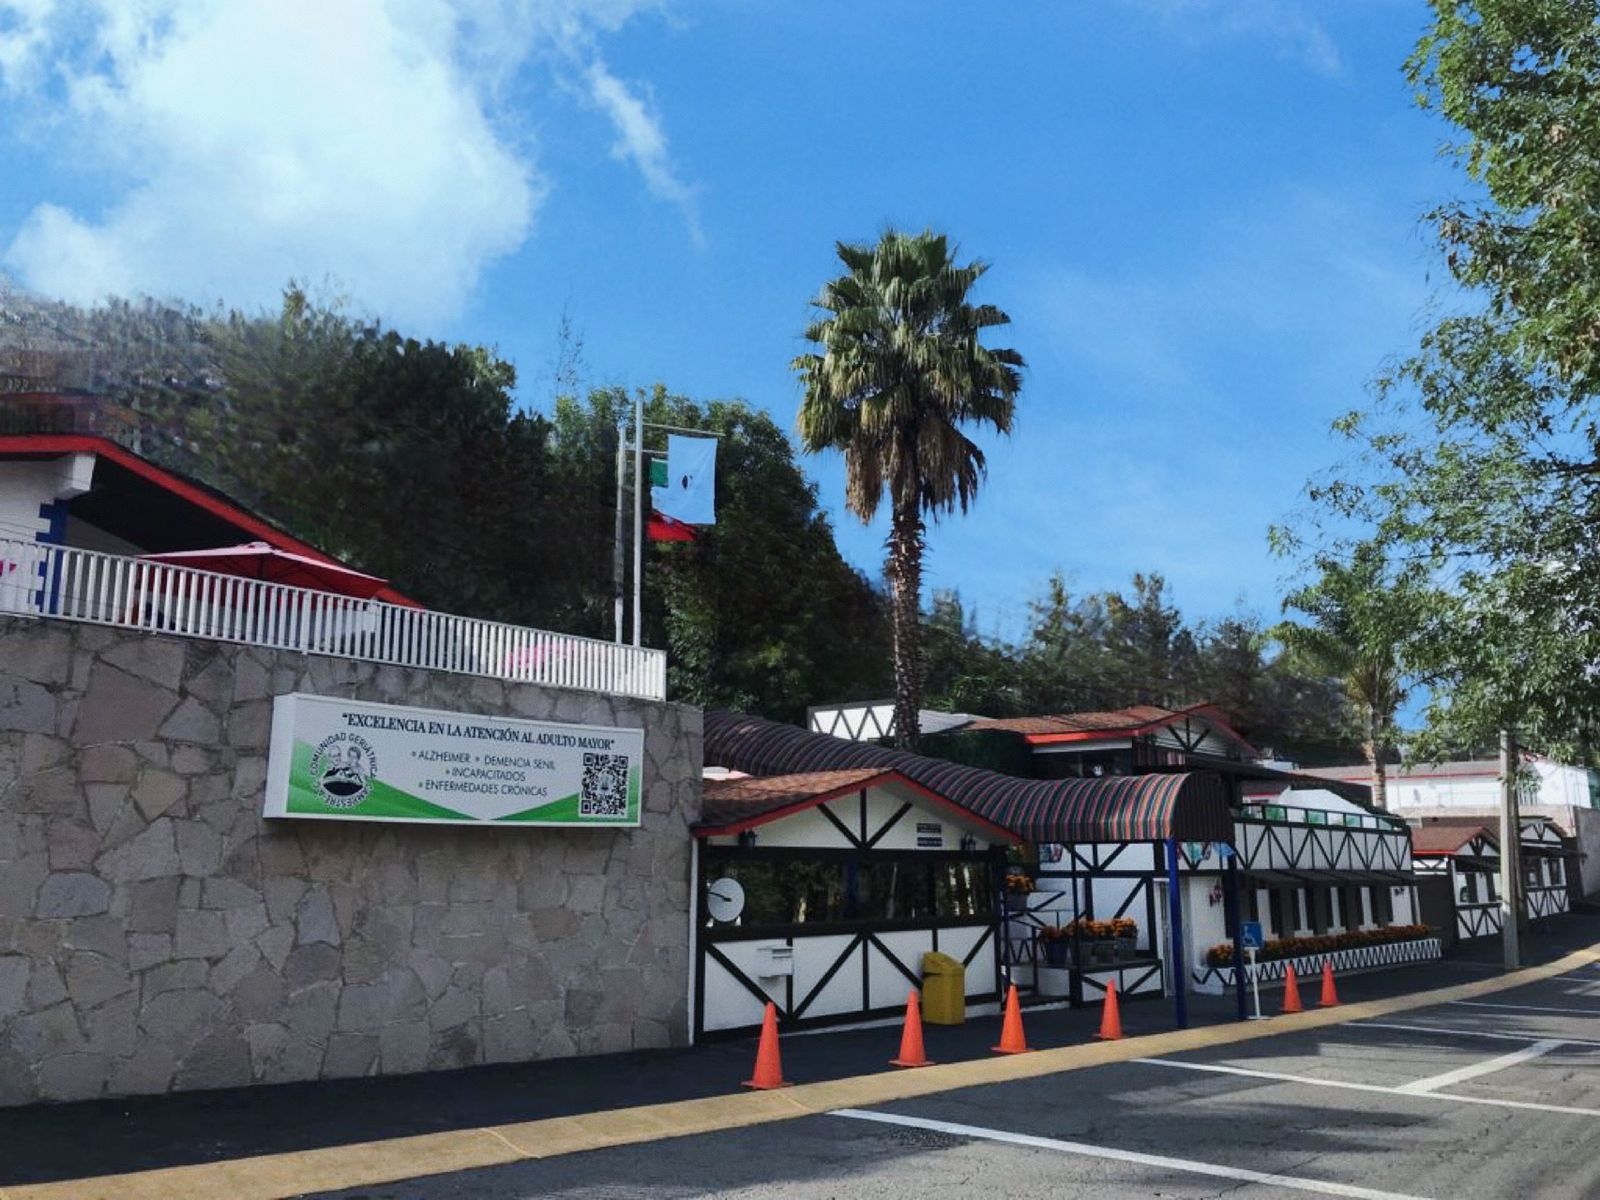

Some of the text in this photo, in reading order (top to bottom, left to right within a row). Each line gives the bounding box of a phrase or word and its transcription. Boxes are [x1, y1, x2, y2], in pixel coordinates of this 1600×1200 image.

[428, 721, 445, 735] EN
[447, 723, 462, 737] LA
[521, 732, 536, 744] AL
[536, 732, 576, 748] ADULTO
[310, 732, 346, 776] COMUNIDAD
[484, 754, 531, 768] DEMENCIA
[451, 767, 526, 782] INCAPACITADOS
[425, 779, 500, 795] ENFERMEDADES
